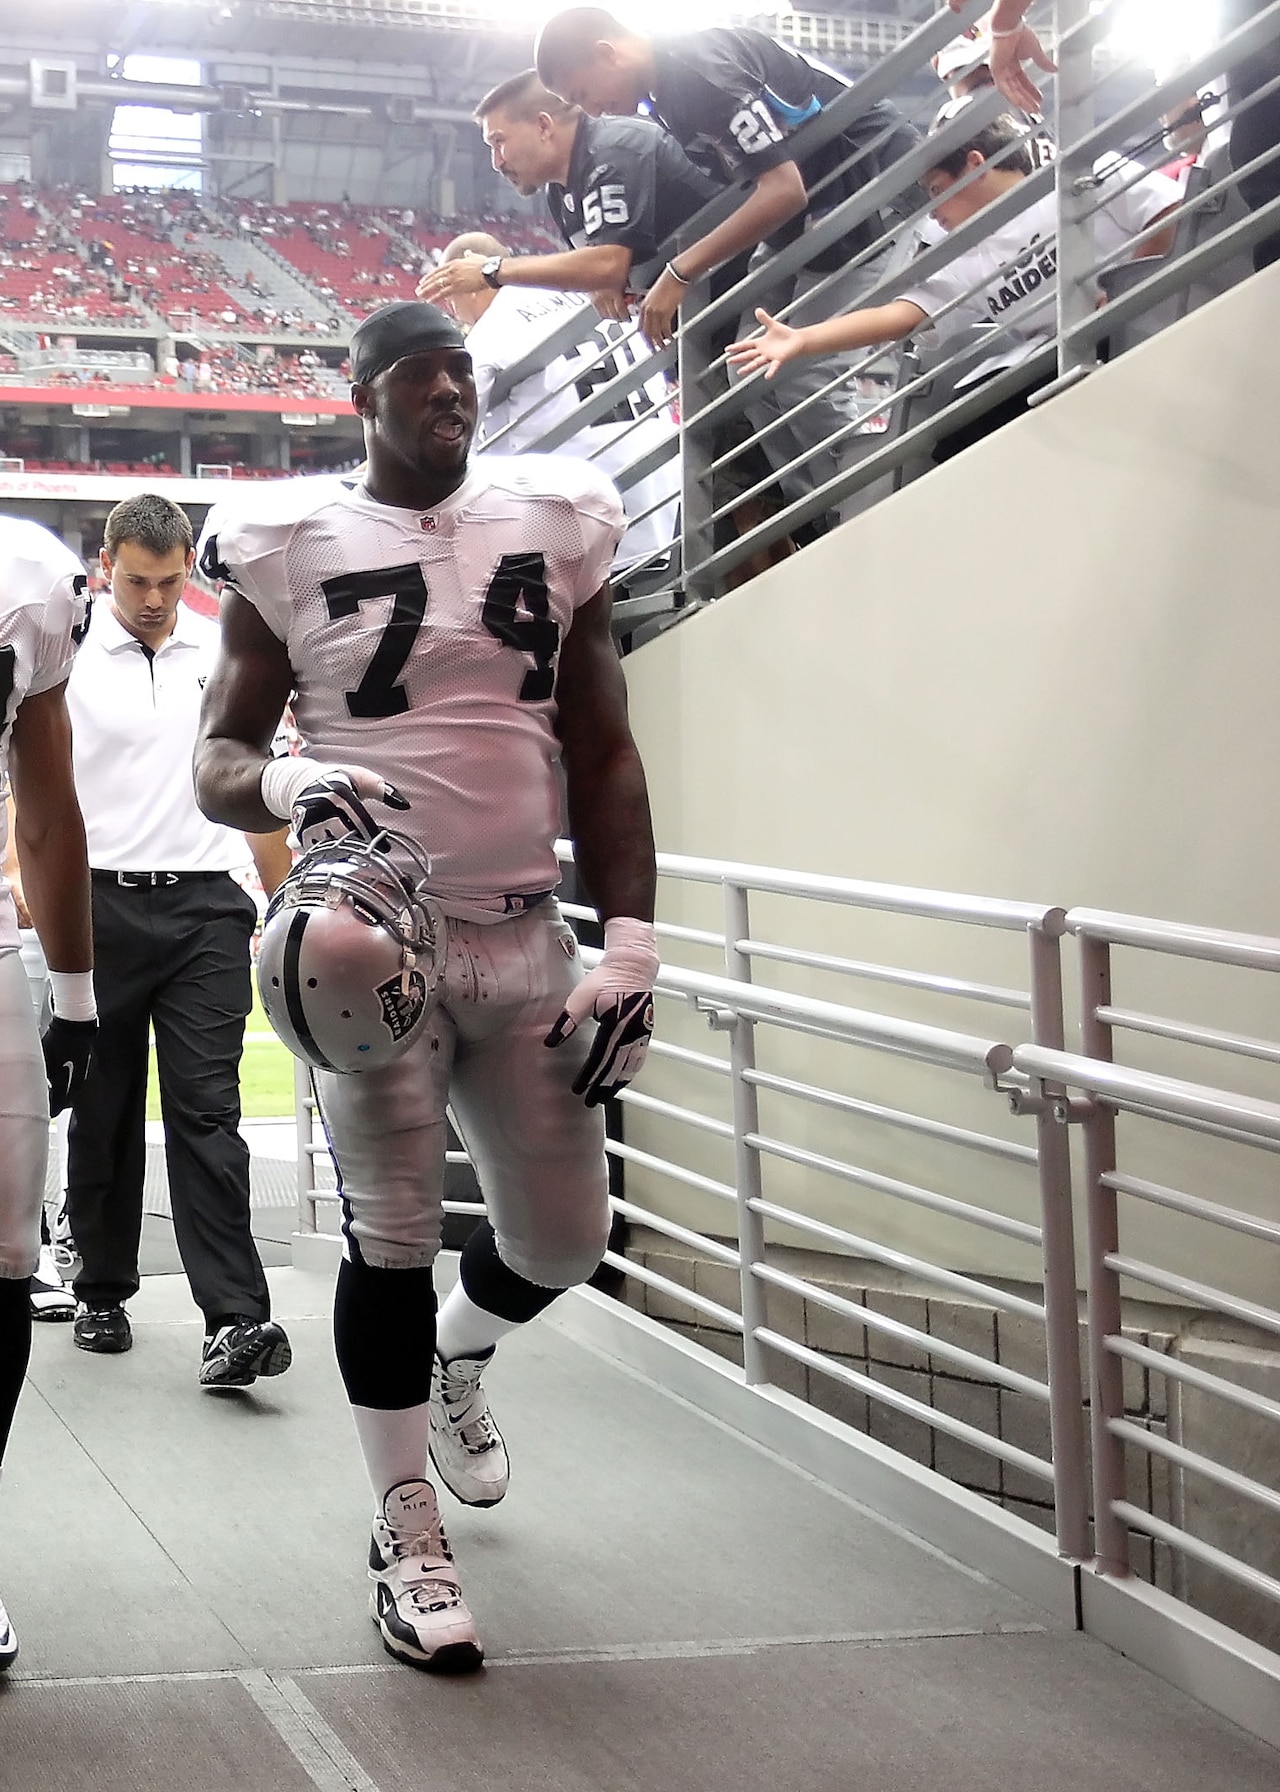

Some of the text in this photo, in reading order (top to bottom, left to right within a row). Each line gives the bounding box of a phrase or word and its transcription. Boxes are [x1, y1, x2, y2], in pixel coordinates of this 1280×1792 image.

[729, 99, 785, 155] 21
[581, 184, 630, 236] 55
[987, 247, 1057, 317] RAIDE
[320, 552, 560, 718] 74
[380, 991, 402, 1037] RAIDERS
[403, 1500, 428, 1512] AIR
